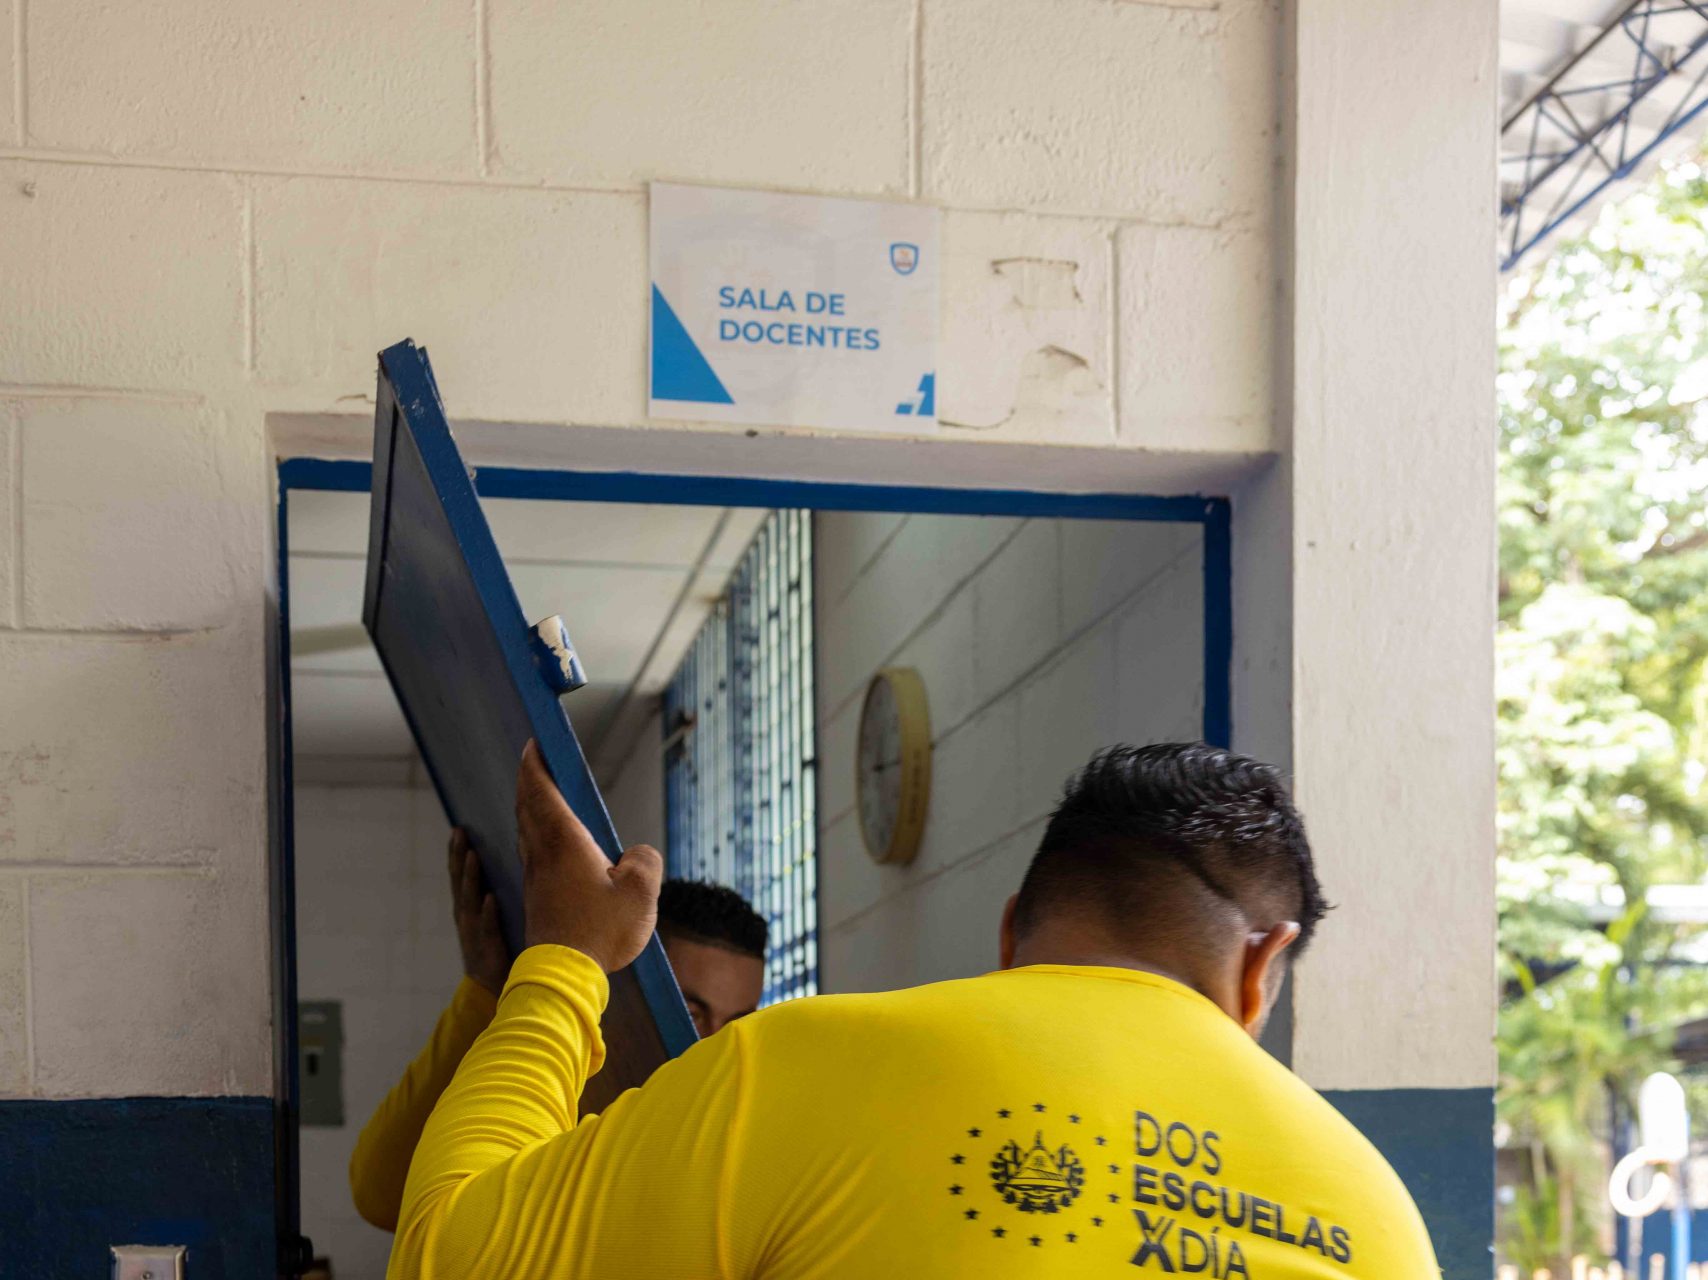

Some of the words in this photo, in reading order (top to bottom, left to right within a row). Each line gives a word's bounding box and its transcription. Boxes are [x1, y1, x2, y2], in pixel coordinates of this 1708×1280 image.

[719, 286, 796, 312] SALA
[806, 292, 845, 316] DE
[719, 319, 880, 350] DOCENTES
[1134, 1110, 1222, 1176] DOS
[1133, 1163, 1351, 1264] ESCUELAS
